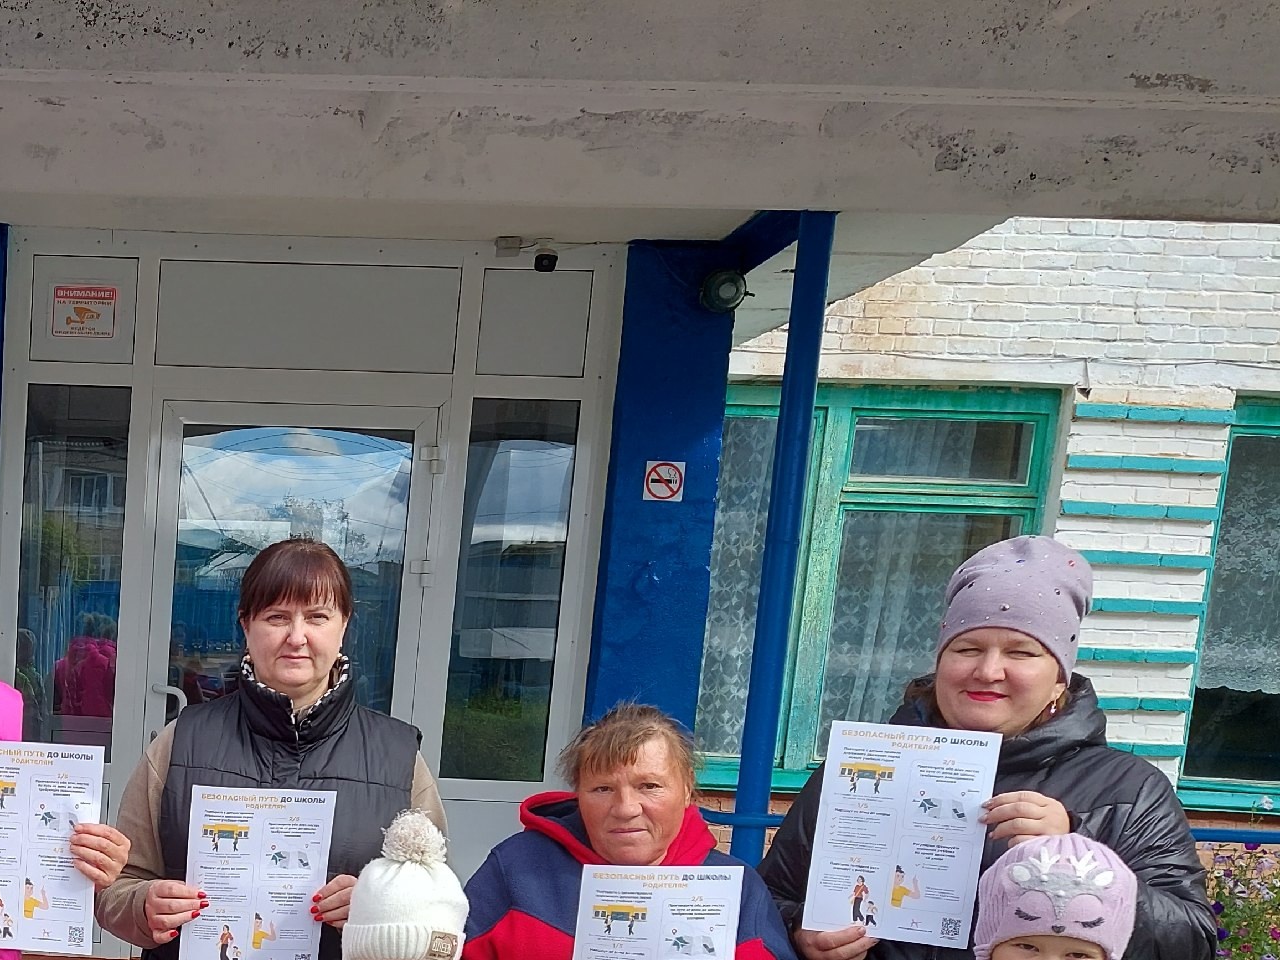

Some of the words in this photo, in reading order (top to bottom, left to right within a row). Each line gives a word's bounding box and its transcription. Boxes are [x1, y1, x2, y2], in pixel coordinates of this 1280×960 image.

[57, 289, 113, 298] ВНИМАНИЕ!
[841, 727, 905, 740] БЕЗОПАСНЫЙ
[906, 734, 931, 742] ПУТЬ
[933, 736, 948, 744] ДО
[949, 737, 988, 747] ШКОЛЫ
[891, 741, 940, 751] РОДИТЕЛЯМ
[23, 749, 44, 757] ПУТЬ
[60, 751, 93, 760] ШКОЛЫ
[11, 757, 53, 765] РОДИТЕЛЯМ
[201, 792, 256, 802] БЕЗОПАСНЫЙ
[245, 802, 286, 810] РОДИТЕЛЯМ
[592, 872, 655, 880] БЕЗОПАСНЫЙ
